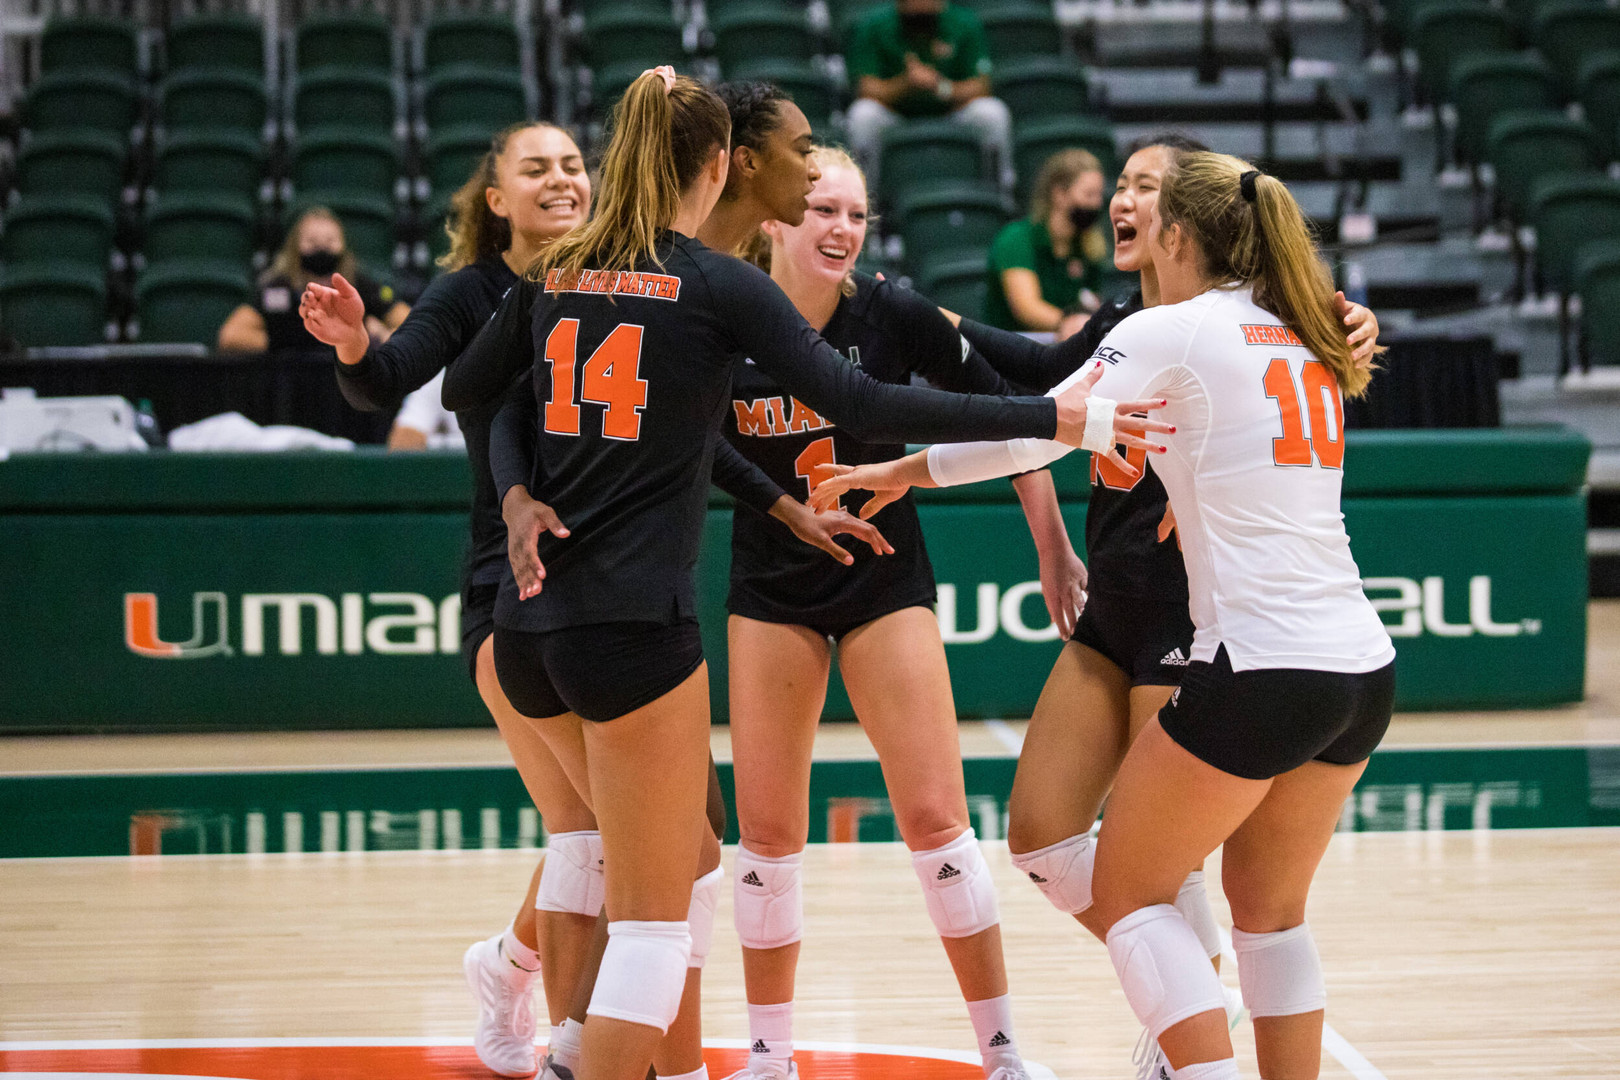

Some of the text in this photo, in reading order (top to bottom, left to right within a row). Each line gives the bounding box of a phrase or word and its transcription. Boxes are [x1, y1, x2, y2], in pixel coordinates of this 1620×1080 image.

[615, 270, 681, 301] MATTER
[1239, 324, 1305, 347] HERNA
[544, 318, 648, 441] 14
[733, 395, 835, 437] MIA
[1262, 358, 1345, 470] 10
[124, 591, 230, 658] U
